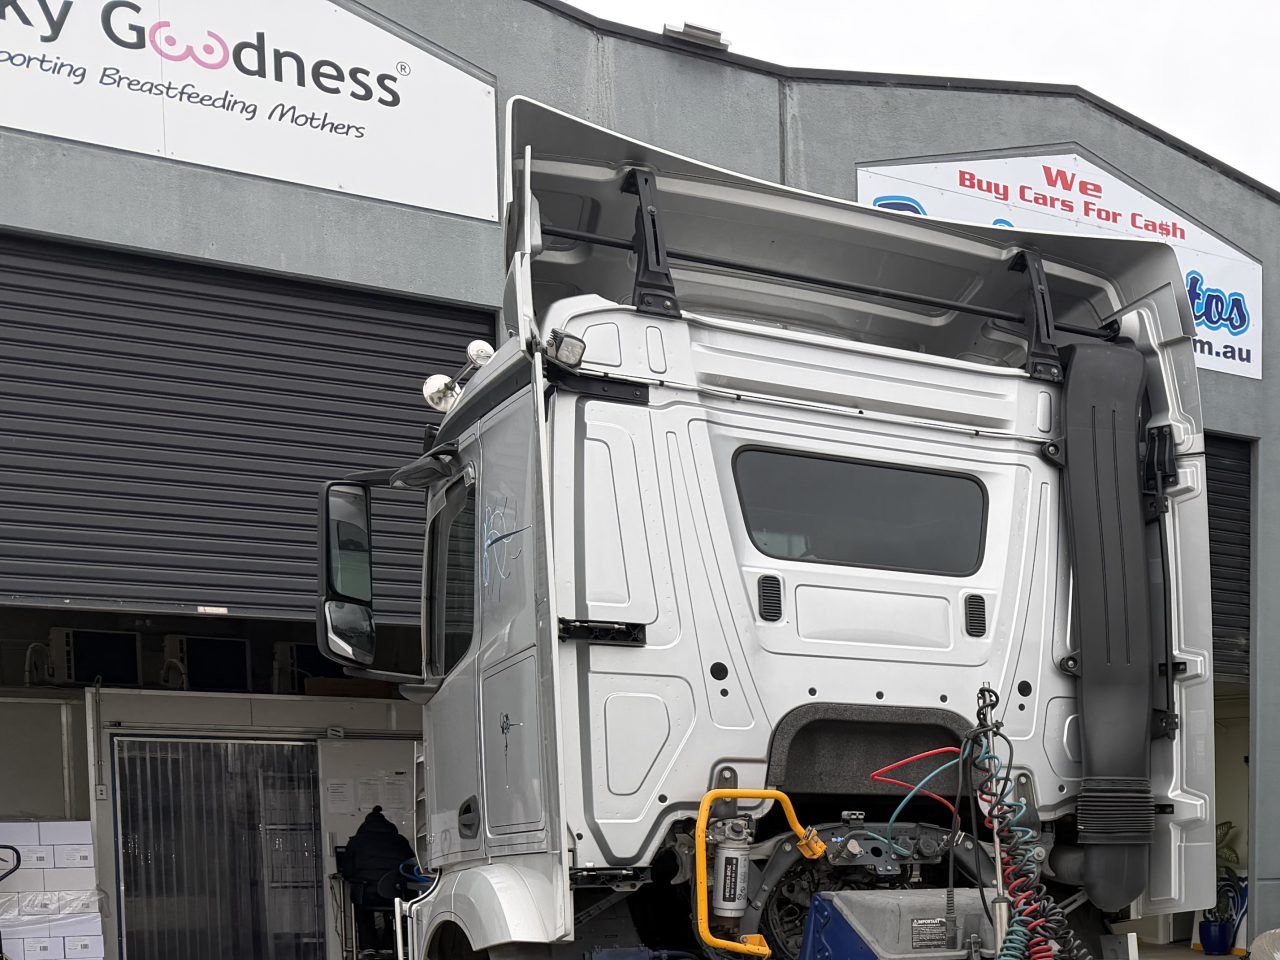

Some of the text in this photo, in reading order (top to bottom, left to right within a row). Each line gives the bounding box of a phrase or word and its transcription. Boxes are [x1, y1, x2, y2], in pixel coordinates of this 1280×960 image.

[99, 67, 258, 121] Breastfeeding
[267, 102, 366, 139] Mothers
[958, 169, 1009, 202] Buy
[1019, 185, 1075, 213] Cars
[1083, 200, 1122, 225] For
[1042, 164, 1103, 199] We
